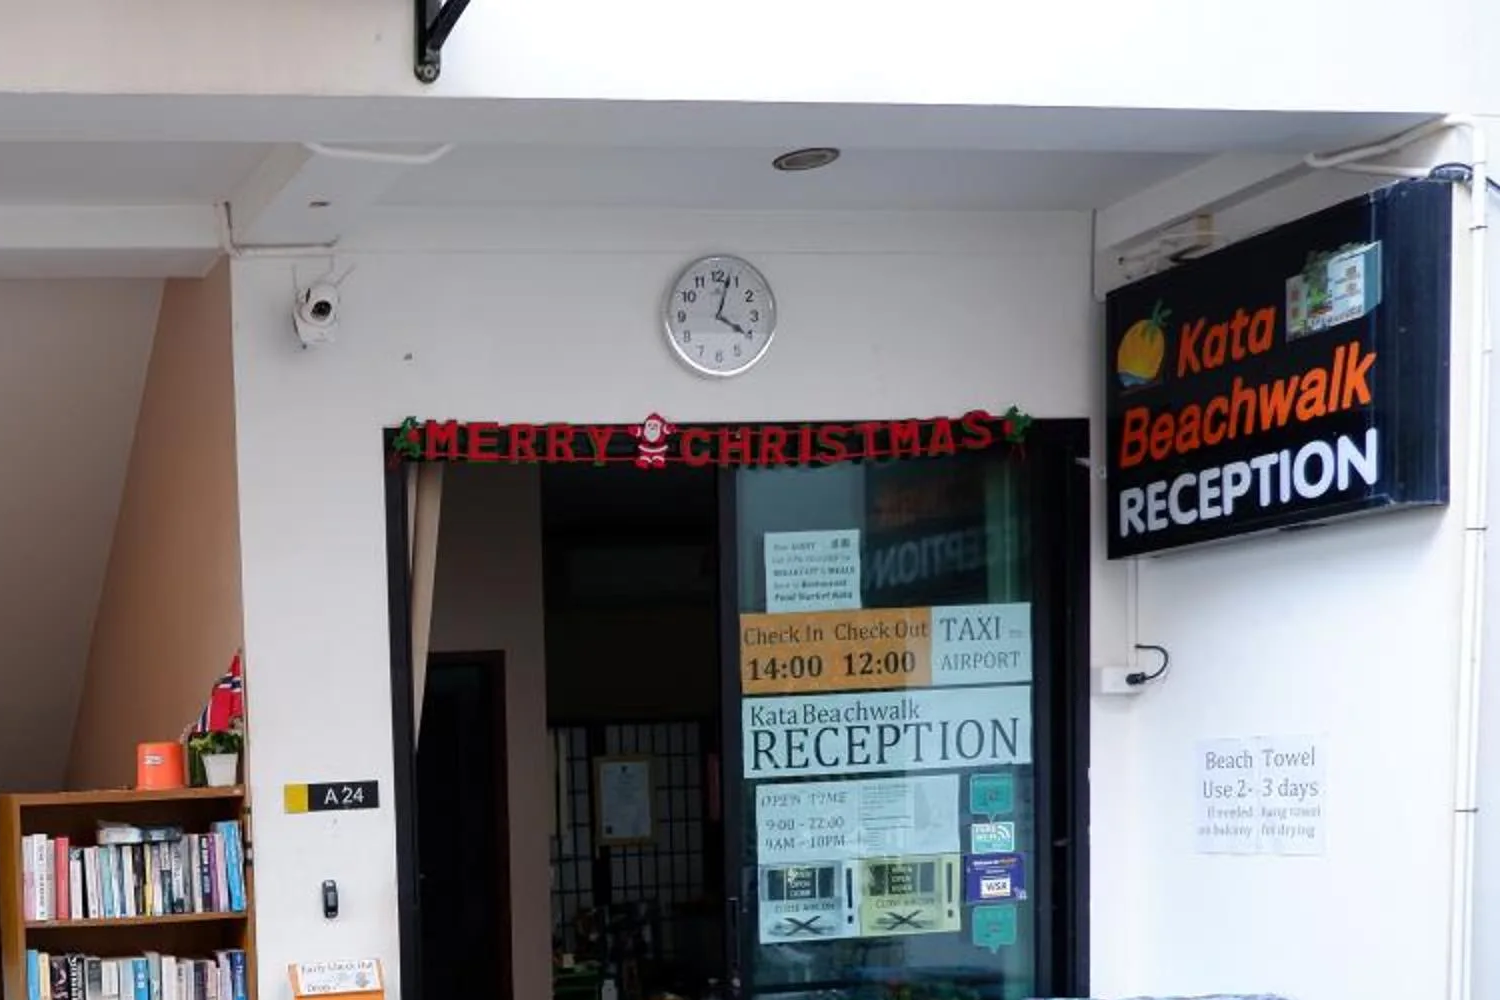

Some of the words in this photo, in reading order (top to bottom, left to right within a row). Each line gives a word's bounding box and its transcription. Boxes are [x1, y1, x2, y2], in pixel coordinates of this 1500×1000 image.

[681, 290, 697, 303] 10
[745, 289, 754, 303] 2
[749, 309, 759, 323] 3
[1177, 305, 1277, 378] Kata
[1118, 341, 1377, 470] Beachwalk
[425, 419, 615, 466] MERRY
[679, 409, 994, 467] CHRISTMAS
[1119, 428, 1378, 538] RECEPTION
[744, 625, 800, 646] Check
[806, 624, 824, 642] In
[834, 619, 889, 641] Check
[895, 619, 929, 639] Out
[939, 615, 1000, 642] TAXI
[748, 655, 823, 681] 14:00
[842, 651, 916, 676] 12:00
[940, 650, 1021, 671] AIRPORT
[750, 704, 798, 727] Kata
[803, 698, 920, 725] Beachwalk
[751, 716, 1021, 771] RECEPTION
[1205, 750, 1253, 770] Beach
[1261, 745, 1315, 768] Towel
[1203, 780, 1233, 799] Use
[1277, 777, 1319, 802] days
